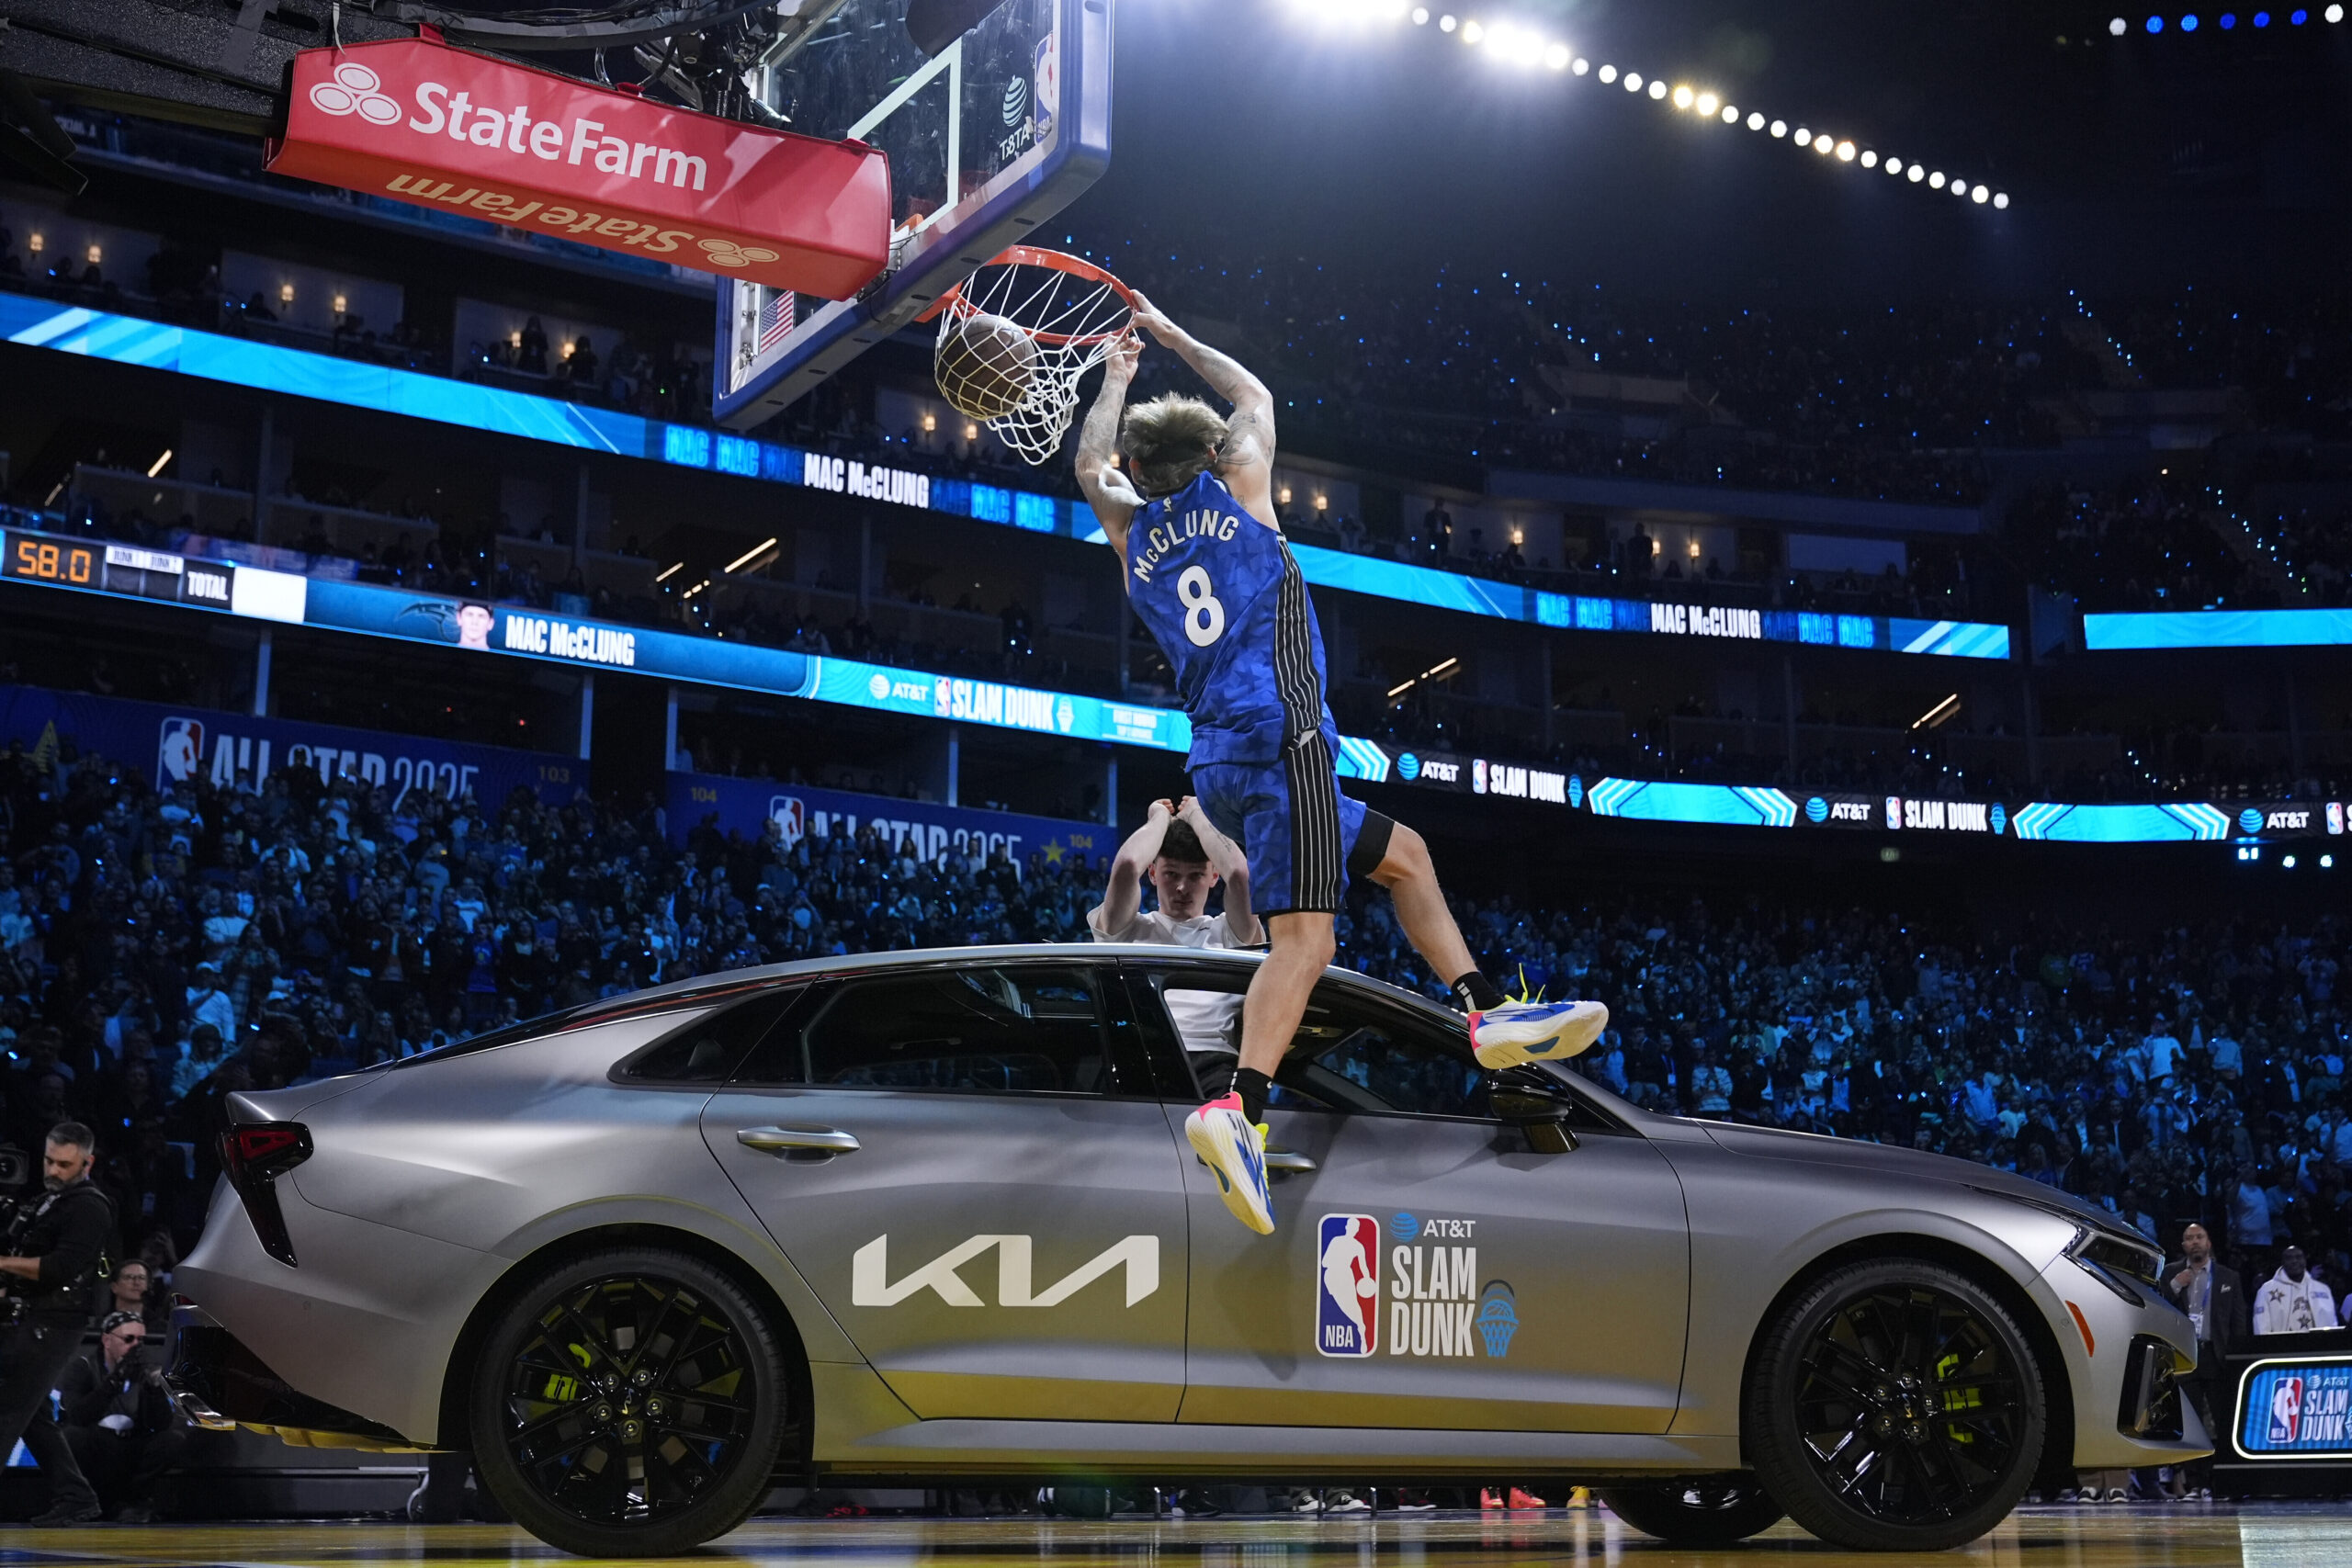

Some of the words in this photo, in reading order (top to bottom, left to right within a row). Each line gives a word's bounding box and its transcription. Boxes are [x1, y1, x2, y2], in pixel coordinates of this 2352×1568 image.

[665, 424, 709, 467] MAC
[717, 434, 760, 477] MAC
[803, 453, 844, 494] MAC
[846, 461, 930, 509] McCLUNG
[970, 484, 1011, 524] MAC
[1014, 492, 1055, 533] MAC
[17, 540, 91, 583] 58.0
[1133, 509, 1238, 583] McCLUNG
[187, 570, 229, 602] TOTAL
[1176, 565, 1225, 647] 8
[505, 615, 548, 653] MAC
[549, 621, 635, 666] McCLUNG
[1651, 603, 1687, 635] MAC
[1689, 605, 1762, 640] McCLUNG
[1798, 611, 1833, 645] MAC
[1838, 615, 1874, 649] MAC
[891, 681, 930, 702] AT&T
[952, 680, 1003, 724] SLAM
[1004, 686, 1055, 731] DUNK
[537, 764, 571, 785] 103
[1420, 761, 1460, 783] AT&T
[1488, 763, 1528, 798] SLAM
[1529, 769, 1566, 805] DUNK
[690, 786, 718, 804] 104
[1830, 803, 1871, 822] AT&T
[1905, 801, 1945, 830] SLAM
[1947, 803, 1988, 833] DUNK
[2266, 811, 2310, 829] AT&T
[1068, 833, 1093, 850] 104
[1423, 1219, 1476, 1238] AT&T
[852, 1234, 1159, 1308] KIA
[1391, 1245, 1476, 1301] SLAM
[1325, 1325, 1354, 1348] NBA
[1390, 1302, 1476, 1357] DUNK
[2323, 1376, 2350, 1386] AT&T
[2303, 1389, 2349, 1415] SLAM
[2301, 1416, 2346, 1440] DUNK
